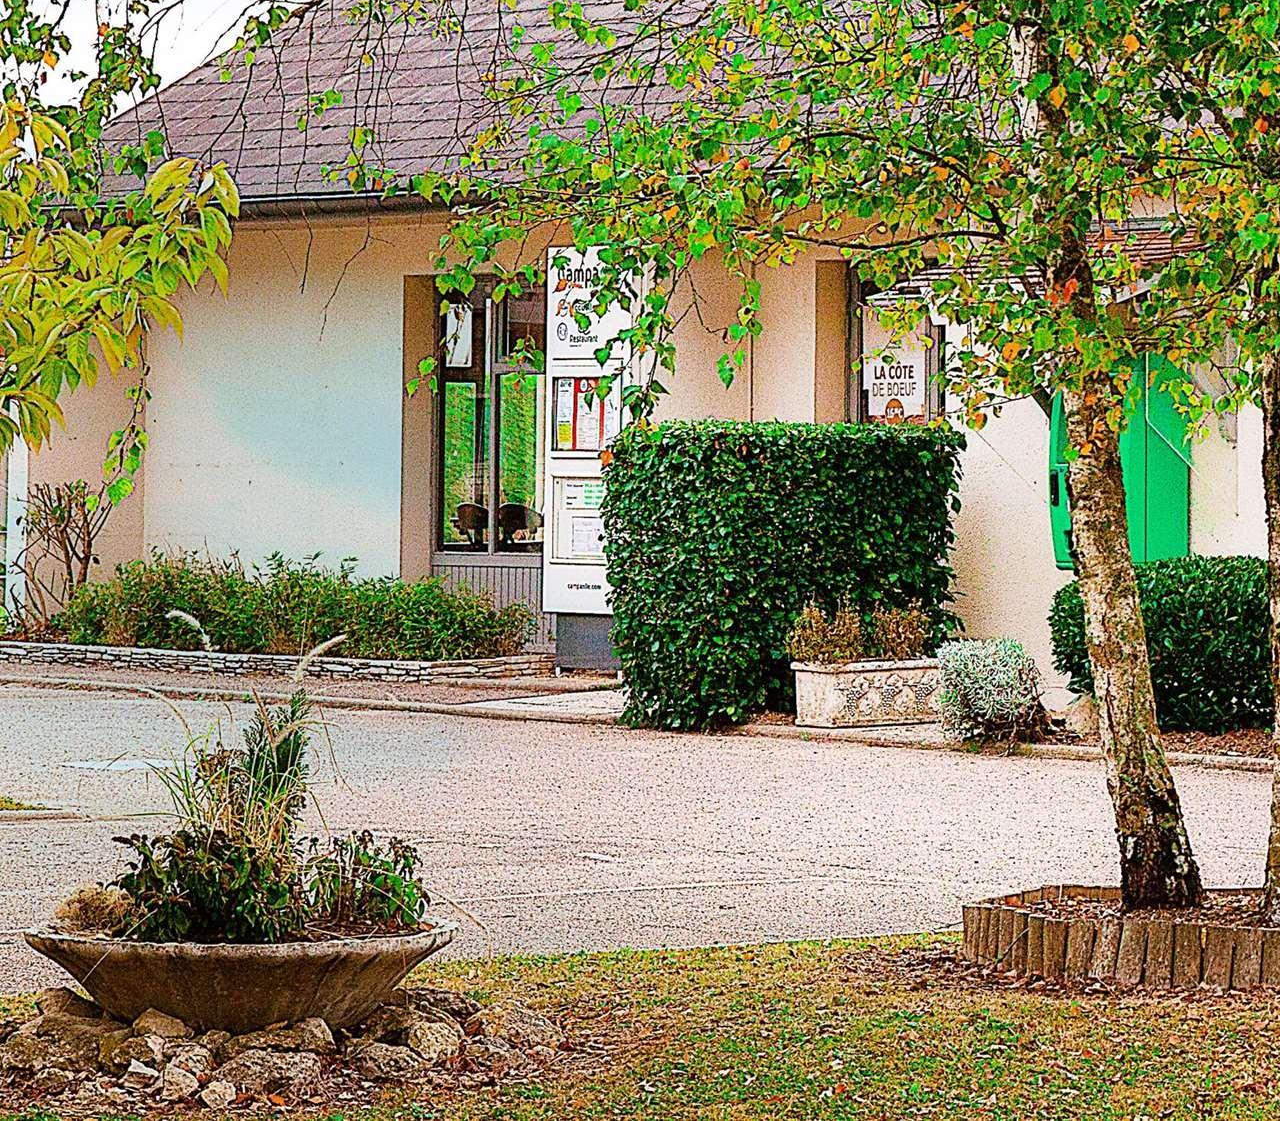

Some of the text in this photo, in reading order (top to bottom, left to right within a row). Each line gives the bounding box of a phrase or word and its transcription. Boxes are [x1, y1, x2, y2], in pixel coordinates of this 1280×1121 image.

[874, 361, 914, 380] LA CÔTE
[872, 382, 917, 396] DE BOEUF
